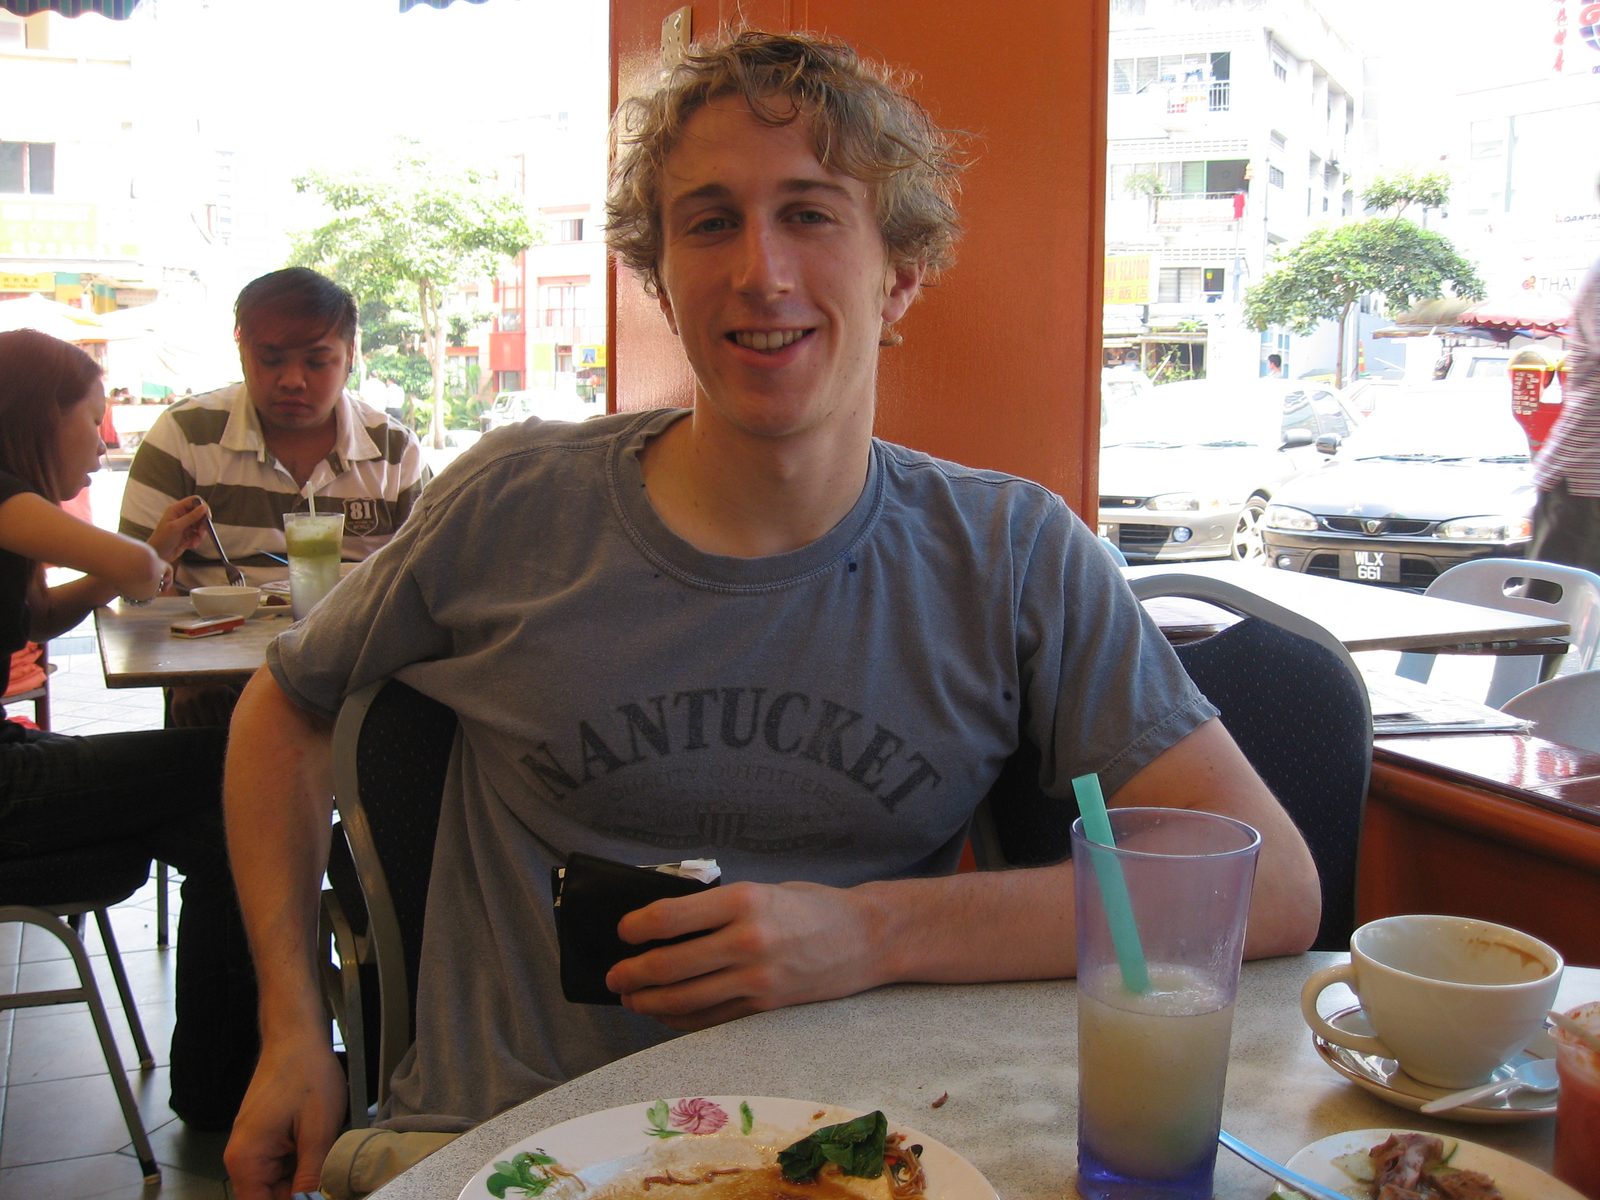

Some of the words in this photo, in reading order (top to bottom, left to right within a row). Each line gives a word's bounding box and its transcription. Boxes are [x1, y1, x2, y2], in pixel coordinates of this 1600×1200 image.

[350, 501, 372, 520] 81
[1354, 551, 1384, 567] WLX
[1357, 565, 1381, 580] 661
[518, 686, 942, 814] NANTUCKET
[607, 766, 698, 802] QUALITY
[708, 764, 842, 807] OUTFITTERS
